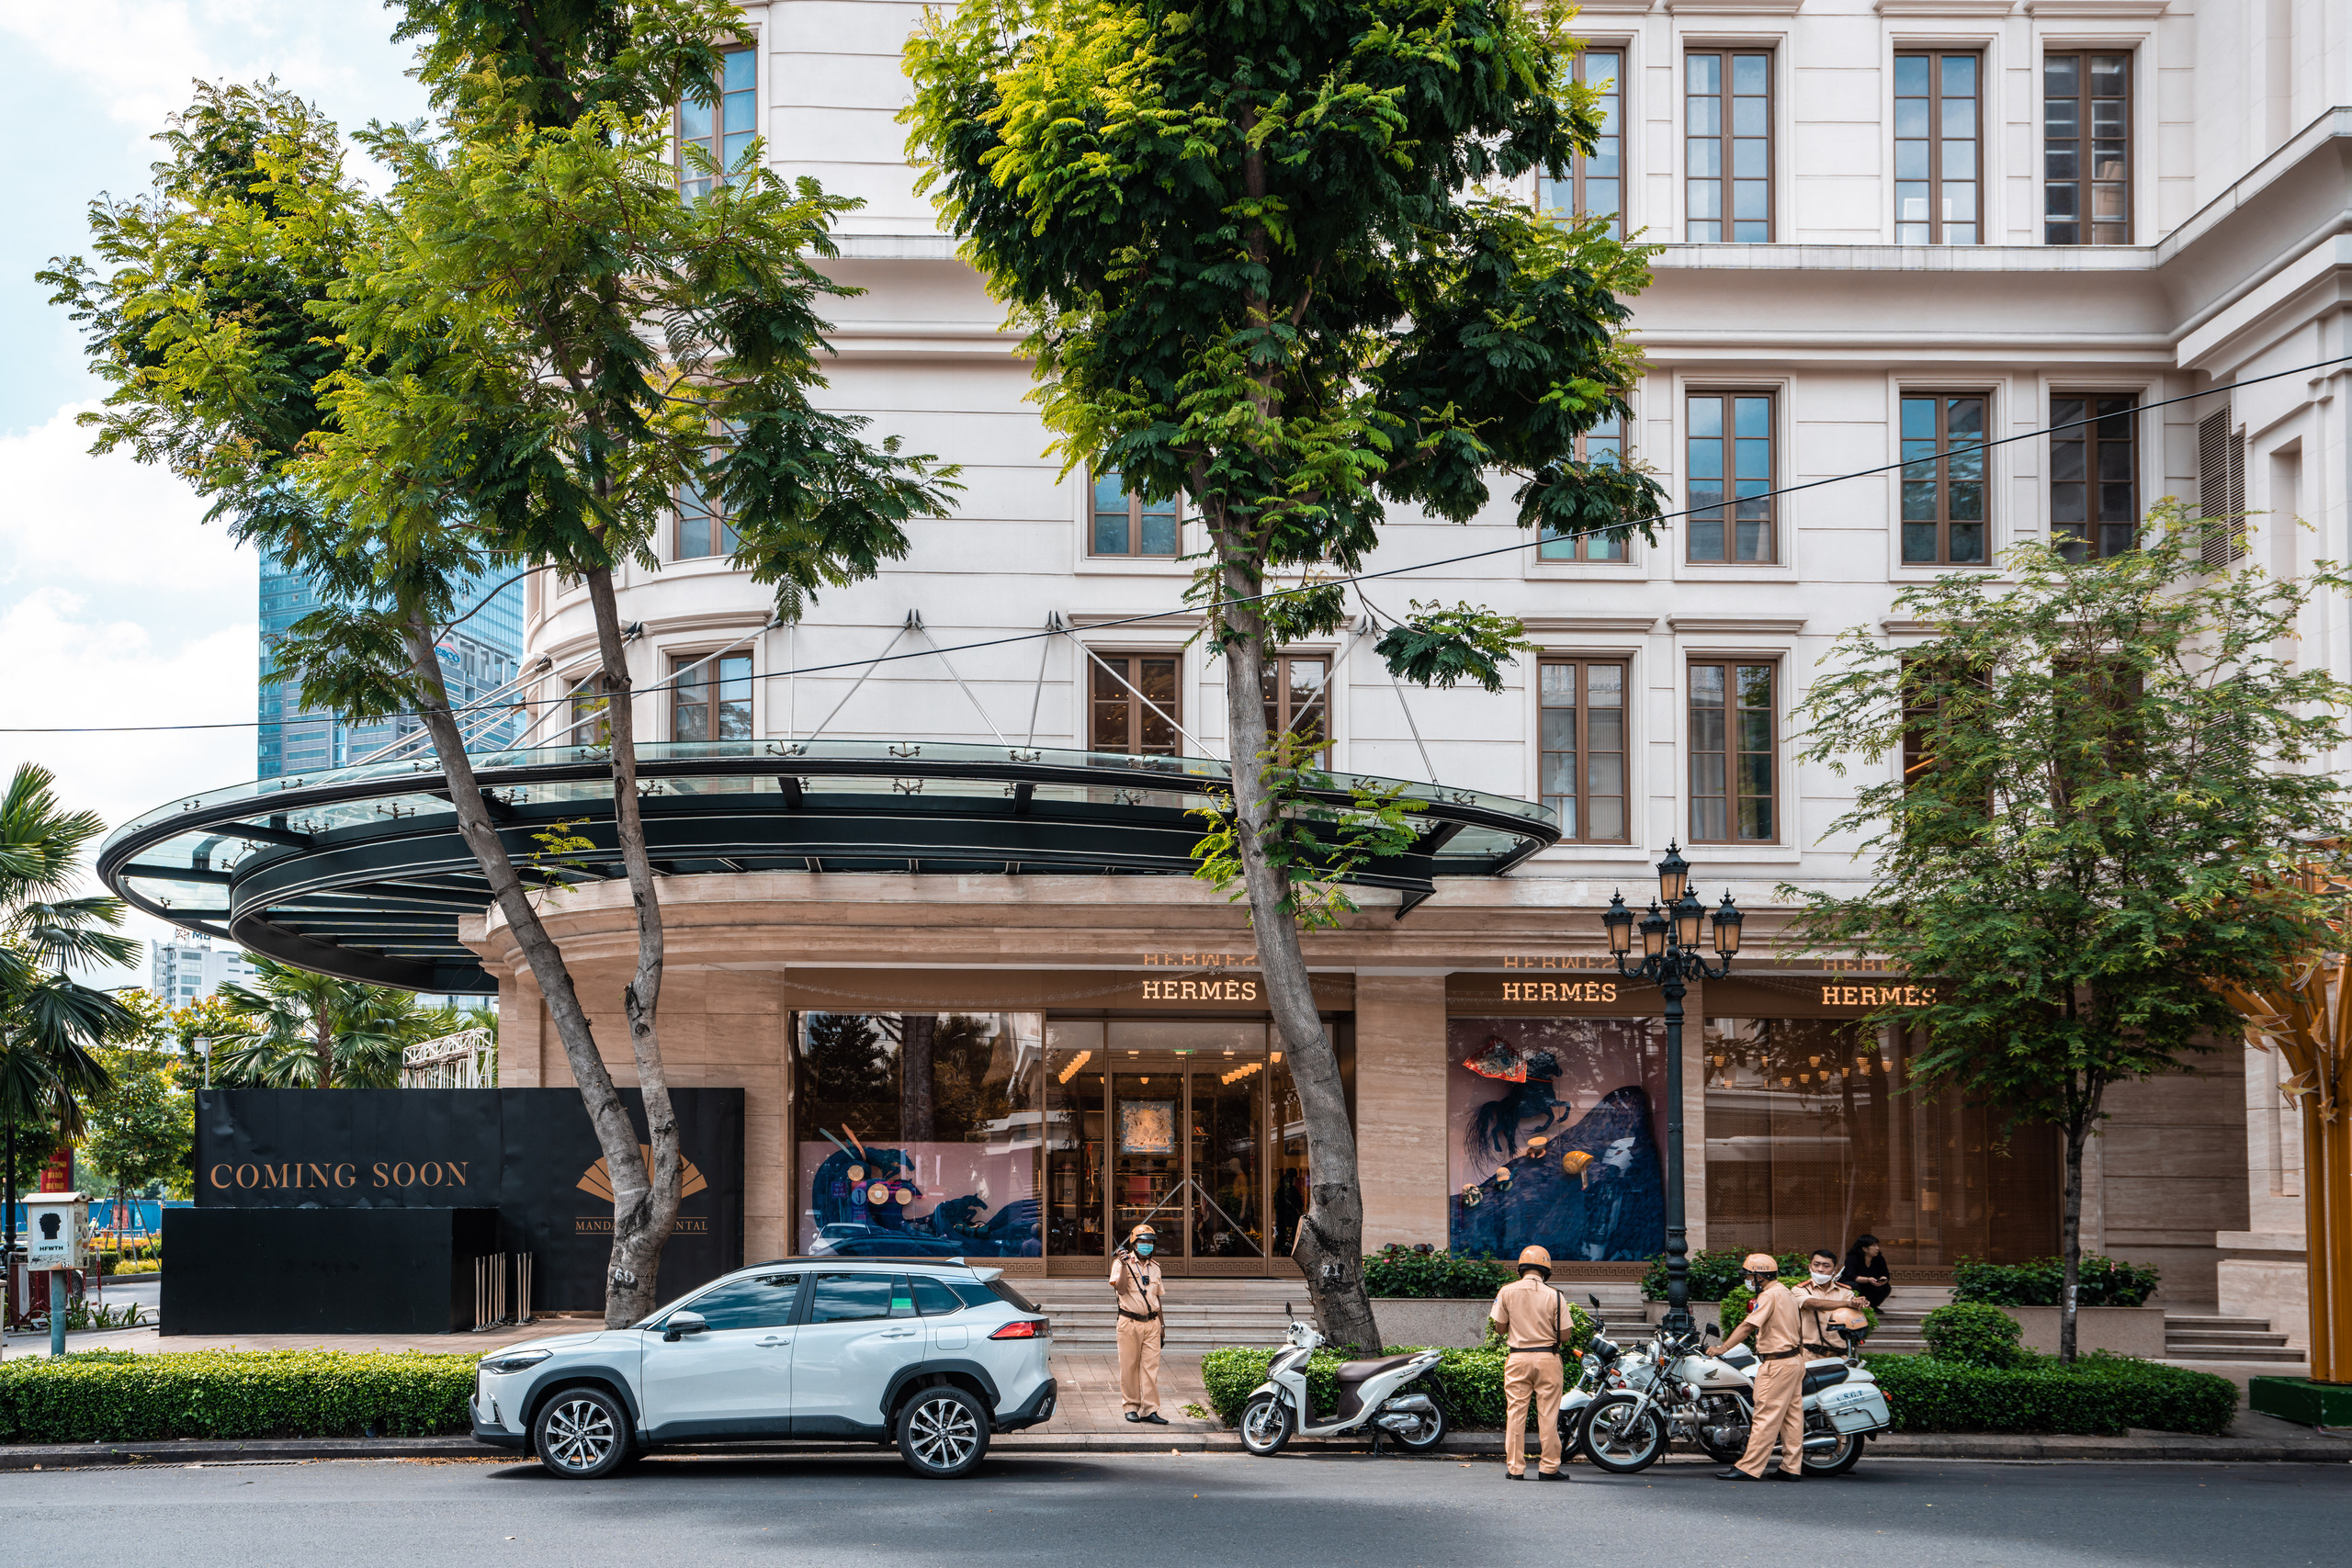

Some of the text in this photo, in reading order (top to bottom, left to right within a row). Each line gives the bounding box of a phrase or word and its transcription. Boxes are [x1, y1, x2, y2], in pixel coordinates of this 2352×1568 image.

[435, 647, 460, 662] ESCO
[1142, 979, 1257, 1000] HERMÈS
[1502, 981, 1617, 1002] HERMÈS
[210, 1161, 469, 1189] COMING SOON
[575, 1221, 708, 1231] MANDA NTAL
[1322, 1264, 1341, 1277] 71
